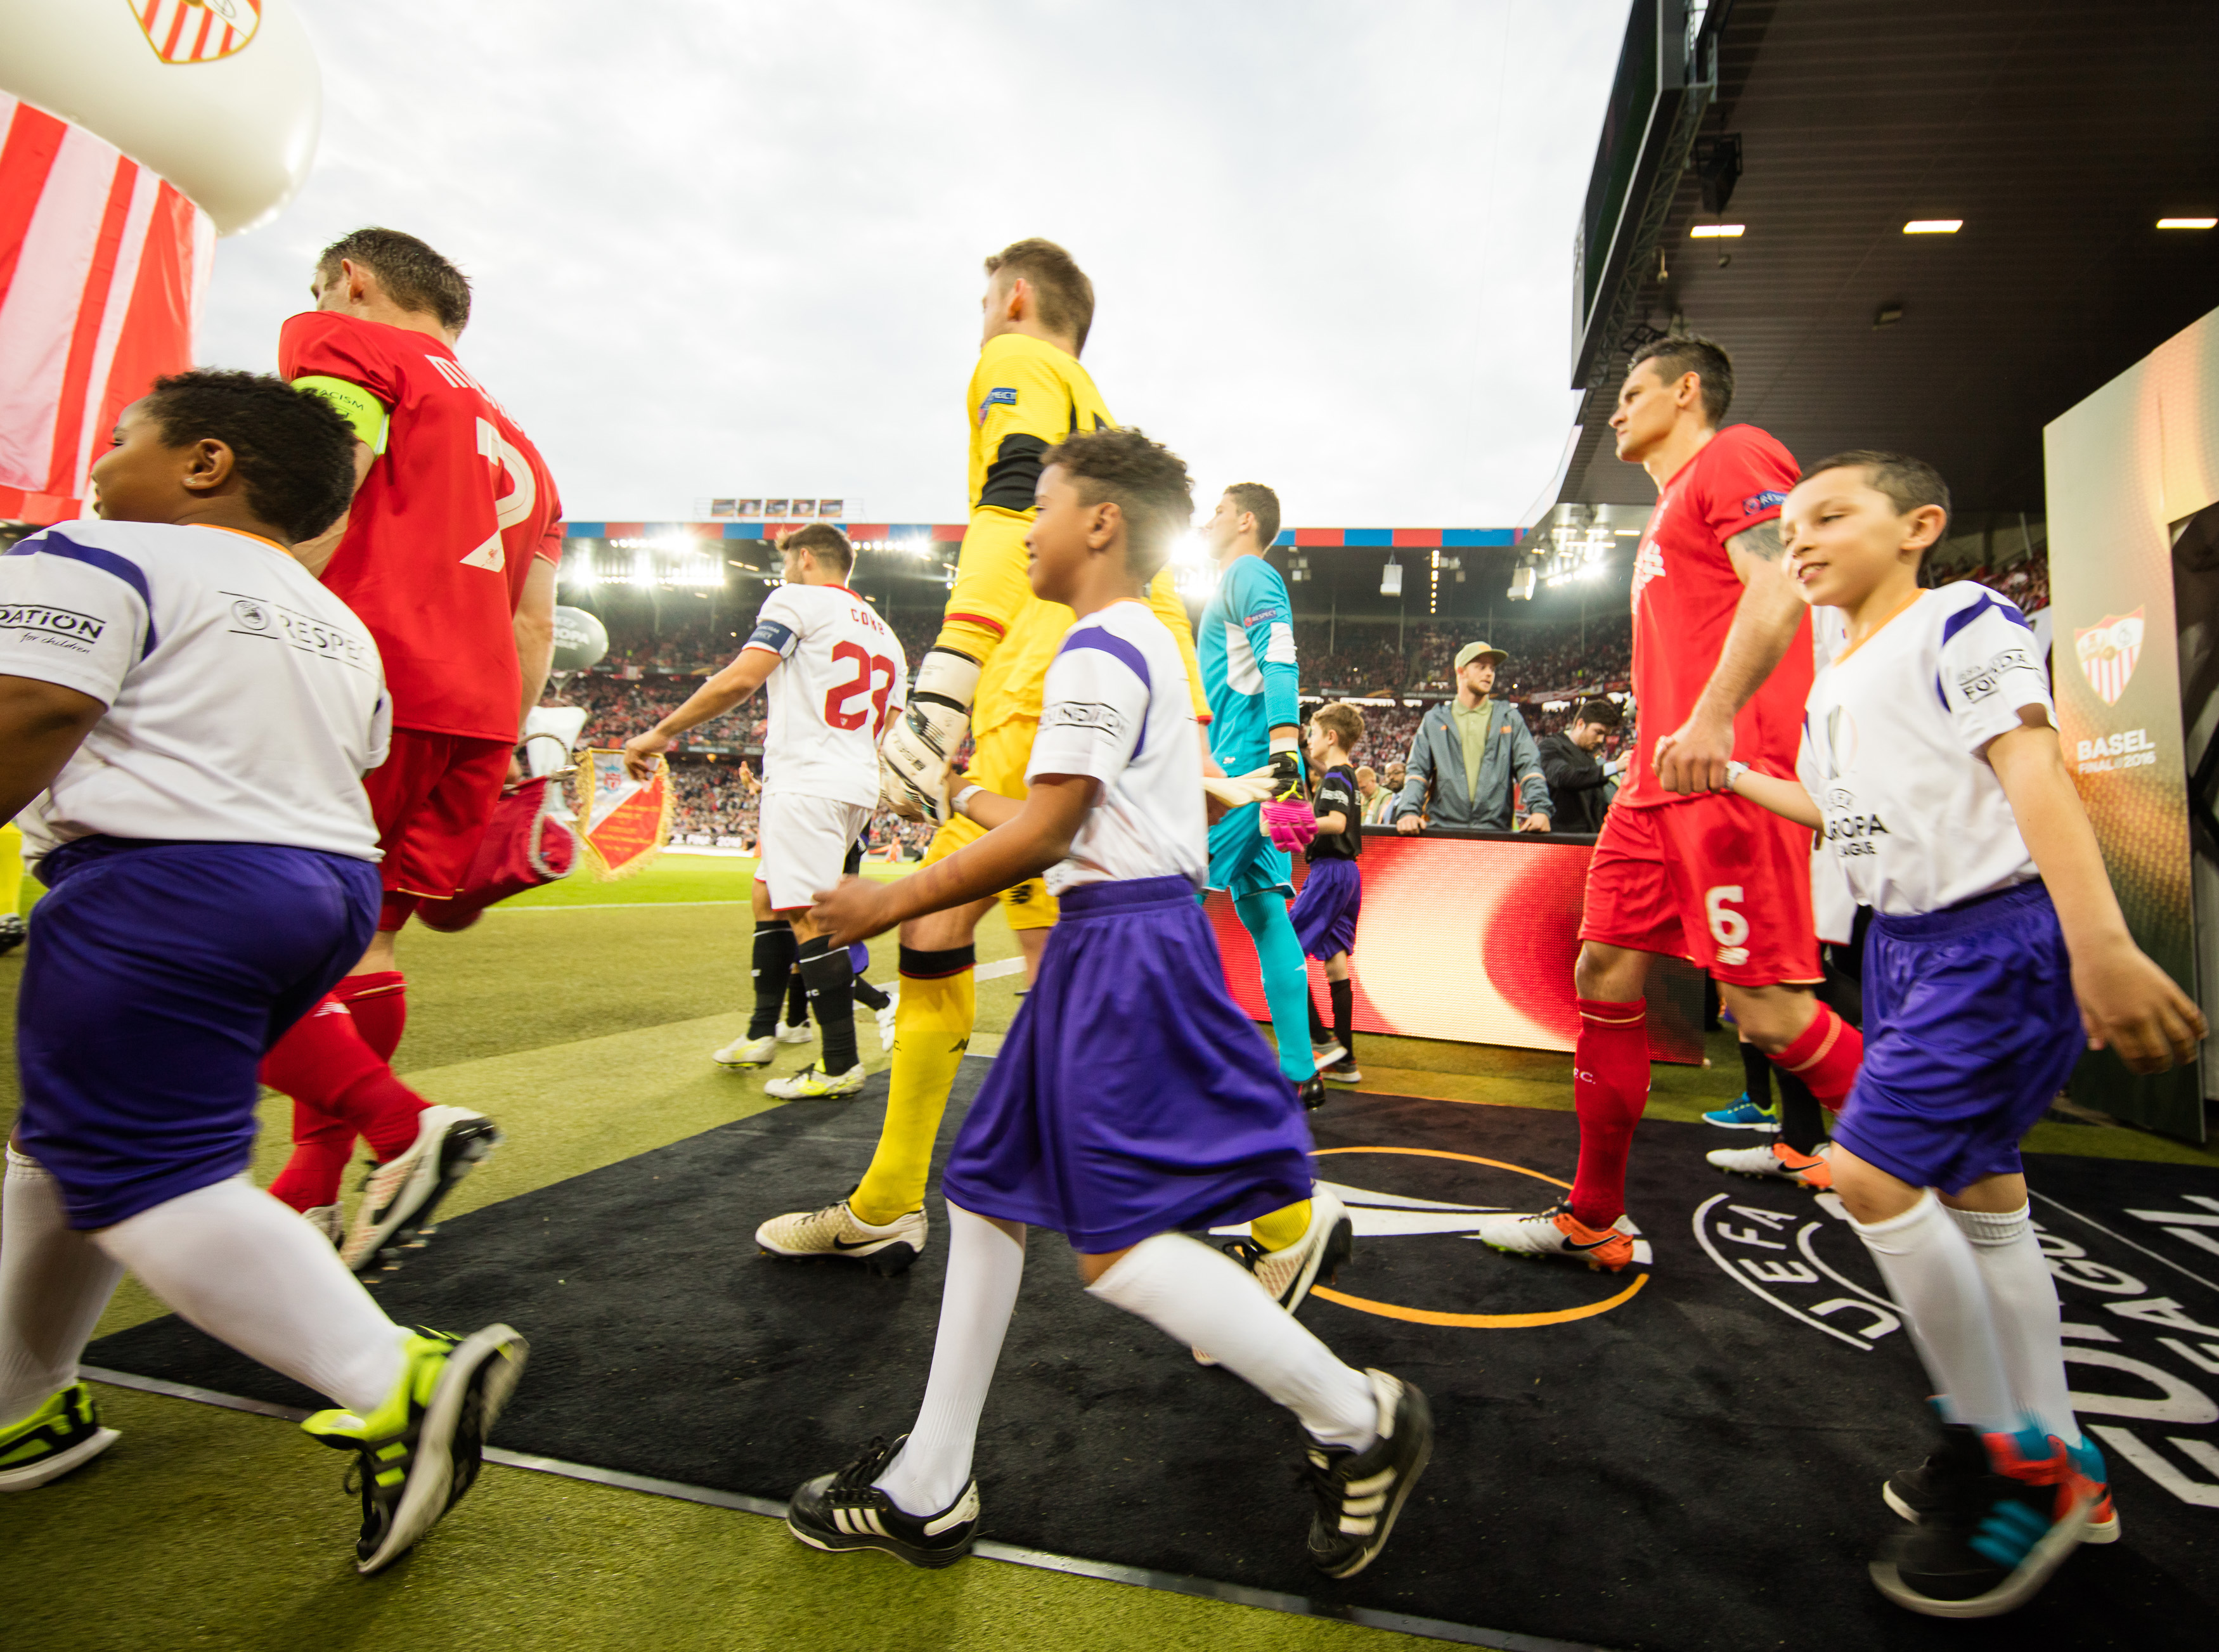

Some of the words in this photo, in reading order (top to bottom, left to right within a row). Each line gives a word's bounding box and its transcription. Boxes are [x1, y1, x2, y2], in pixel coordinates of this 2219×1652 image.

[318, 389, 363, 411] ACISM
[1252, 610, 1276, 622] RESPECT
[41, 636, 91, 654] children
[278, 612, 377, 668] RESPEC
[2077, 728, 2156, 761] BASEL
[2078, 758, 2115, 775] FINAL
[2123, 751, 2156, 768] 2016
[1704, 884, 1750, 947] 6
[1716, 1204, 1901, 1339] UEFA
